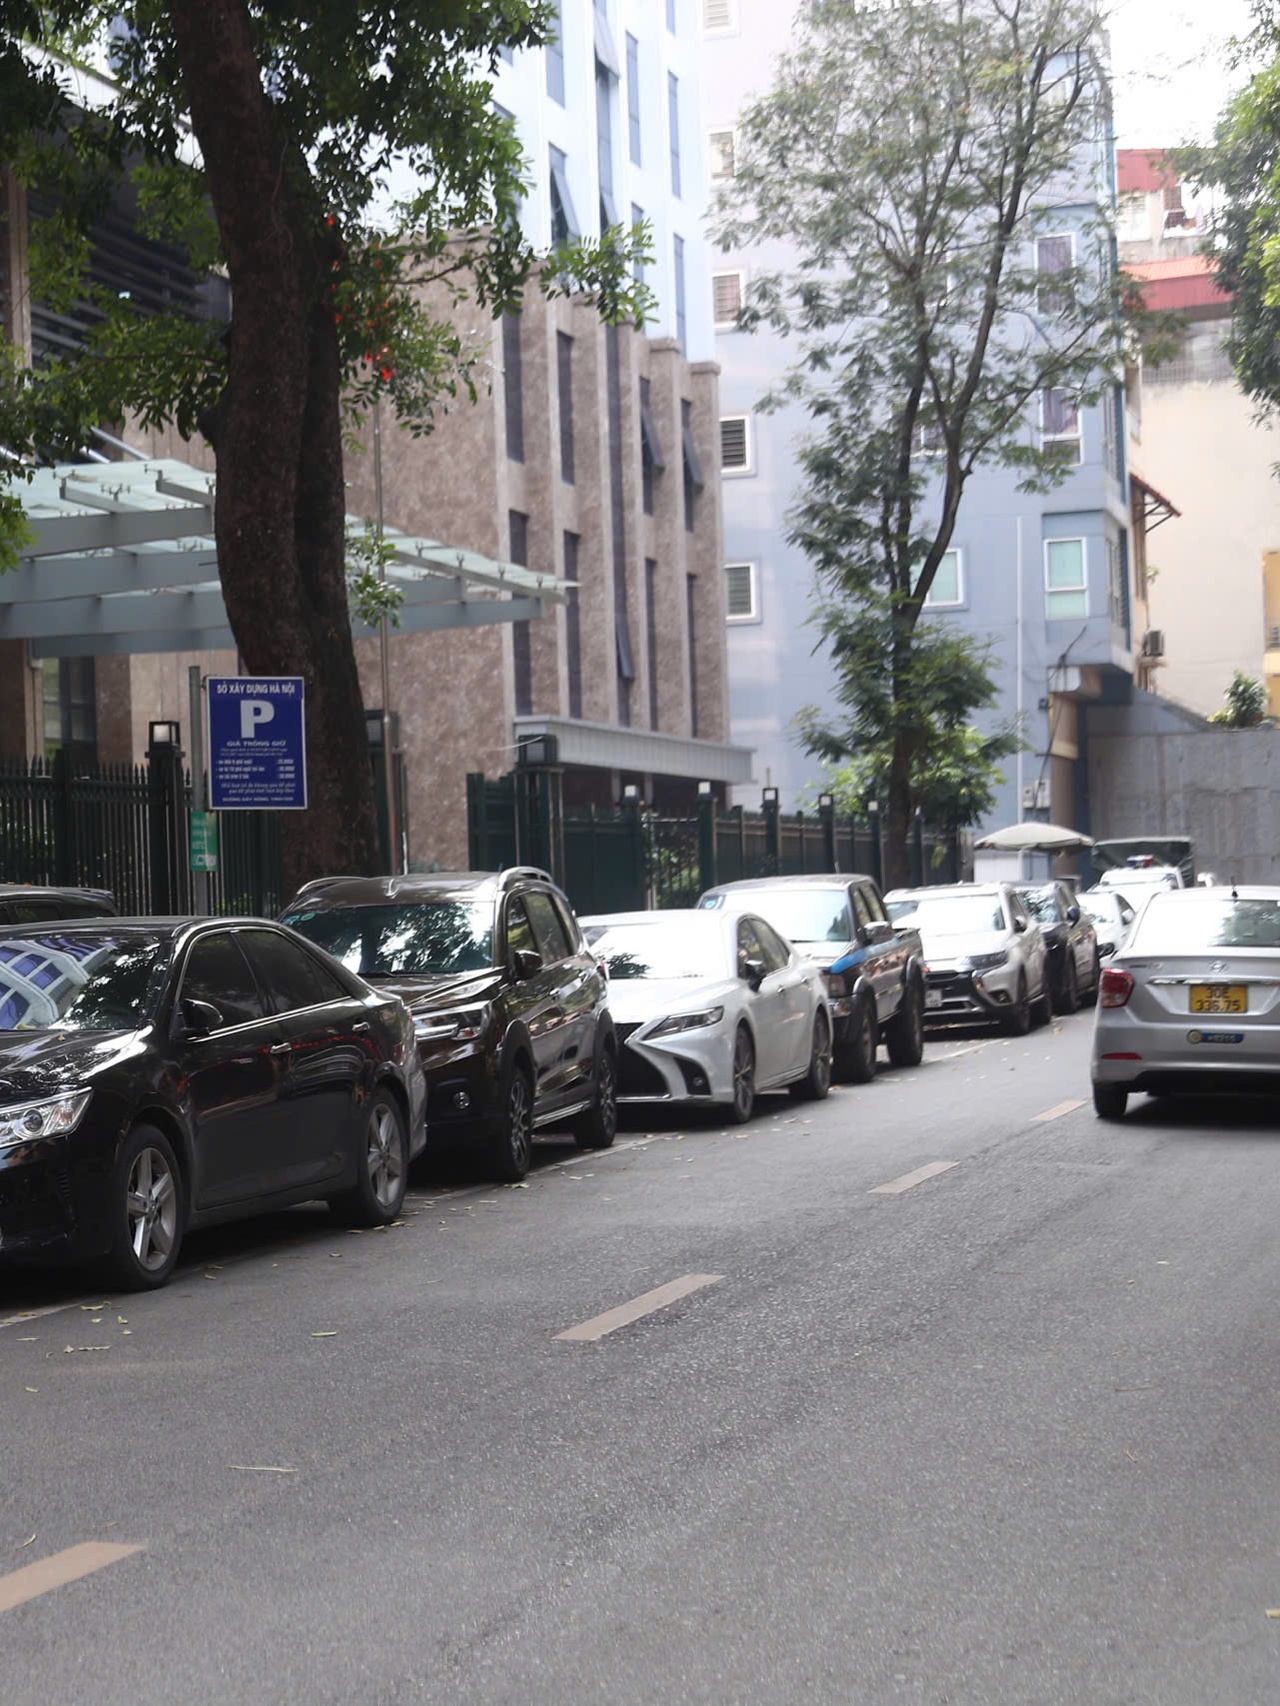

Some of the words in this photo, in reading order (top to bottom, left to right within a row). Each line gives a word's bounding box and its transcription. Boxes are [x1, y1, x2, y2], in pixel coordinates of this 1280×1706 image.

[246, 683, 268, 697] DỰNG
[269, 682, 280, 694] HÀ
[281, 682, 295, 696] NỘI
[240, 699, 275, 739] P
